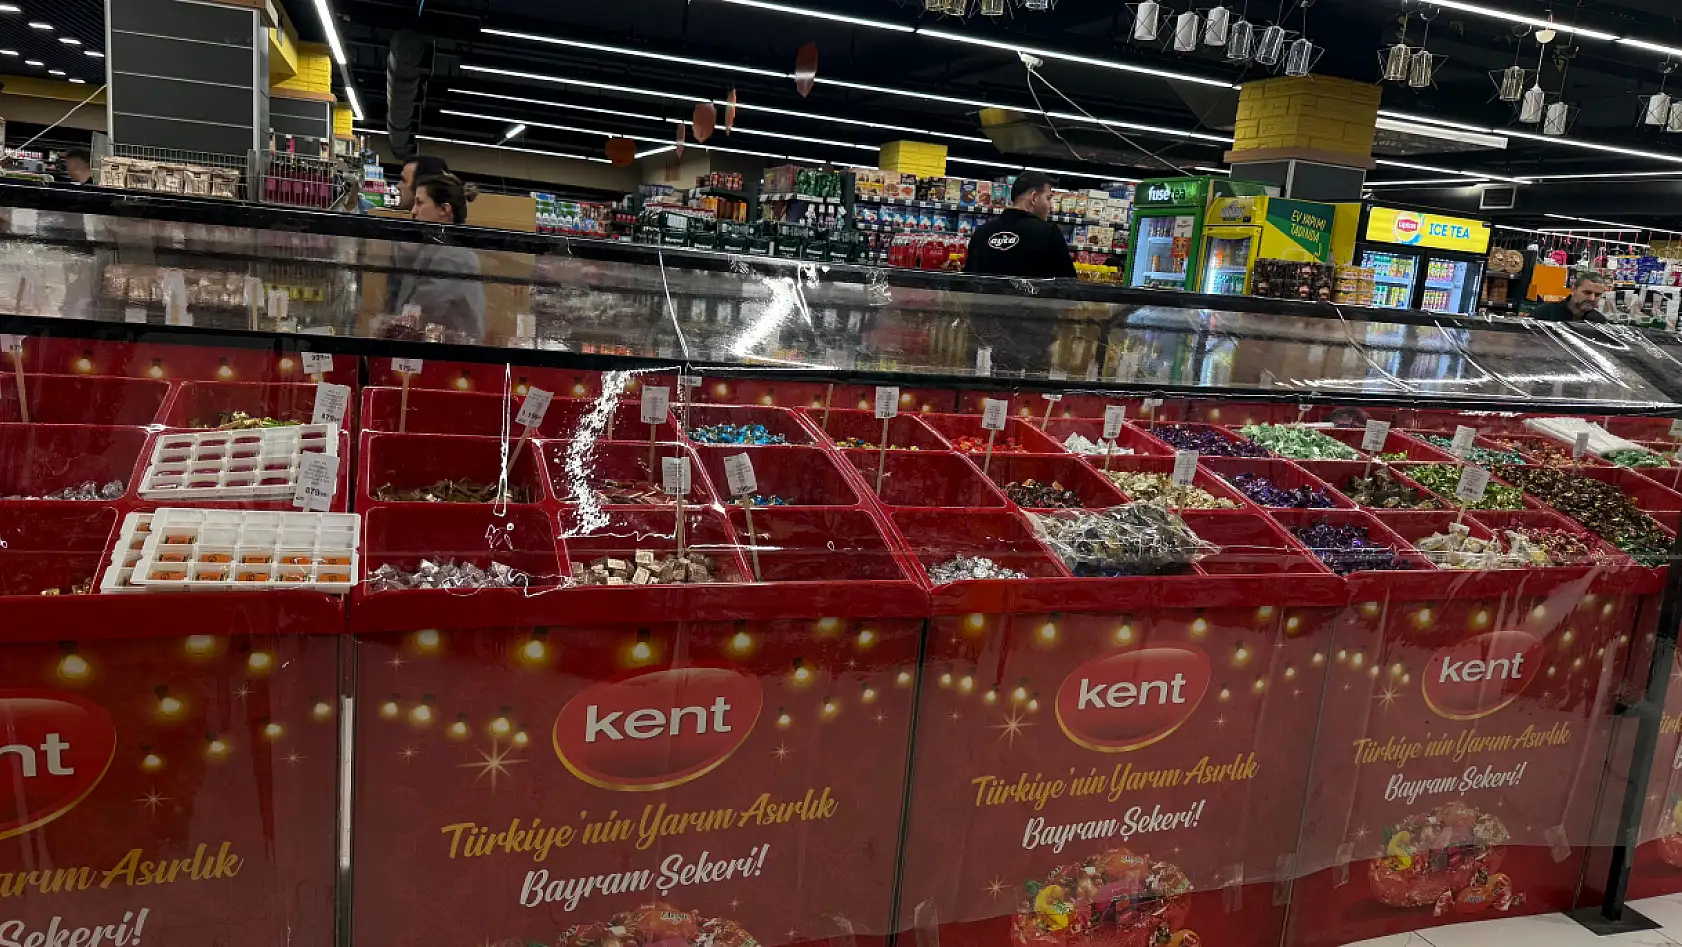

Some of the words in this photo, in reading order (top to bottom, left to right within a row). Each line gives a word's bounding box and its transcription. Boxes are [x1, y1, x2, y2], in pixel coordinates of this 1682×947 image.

[1429, 223, 1447, 237] ICE
[1451, 226, 1470, 239] TEA
[1077, 673, 1187, 710] kent
[1439, 652, 1524, 684] kent
[585, 697, 732, 742] kent
[1353, 731, 1455, 768] Türkiye'nin
[1453, 728, 1514, 763] Yarım
[1513, 721, 1572, 750] Asırlık
[971, 766, 1108, 811] Türkiye'nin
[1108, 762, 1184, 803] Yarım
[1183, 752, 1260, 786] Asırlık
[1384, 772, 1459, 805] Bayram
[1458, 761, 1528, 796] Şekeri!
[441, 809, 637, 862] Türkiye'nin
[636, 803, 738, 850] Yarım
[737, 786, 840, 828] Asırlık
[1021, 817, 1118, 854] Bayram
[1119, 799, 1207, 842] Şekeri!
[100, 841, 244, 889] Asırlık
[519, 868, 654, 912] Bayram
[655, 843, 770, 897] Şekeri!
